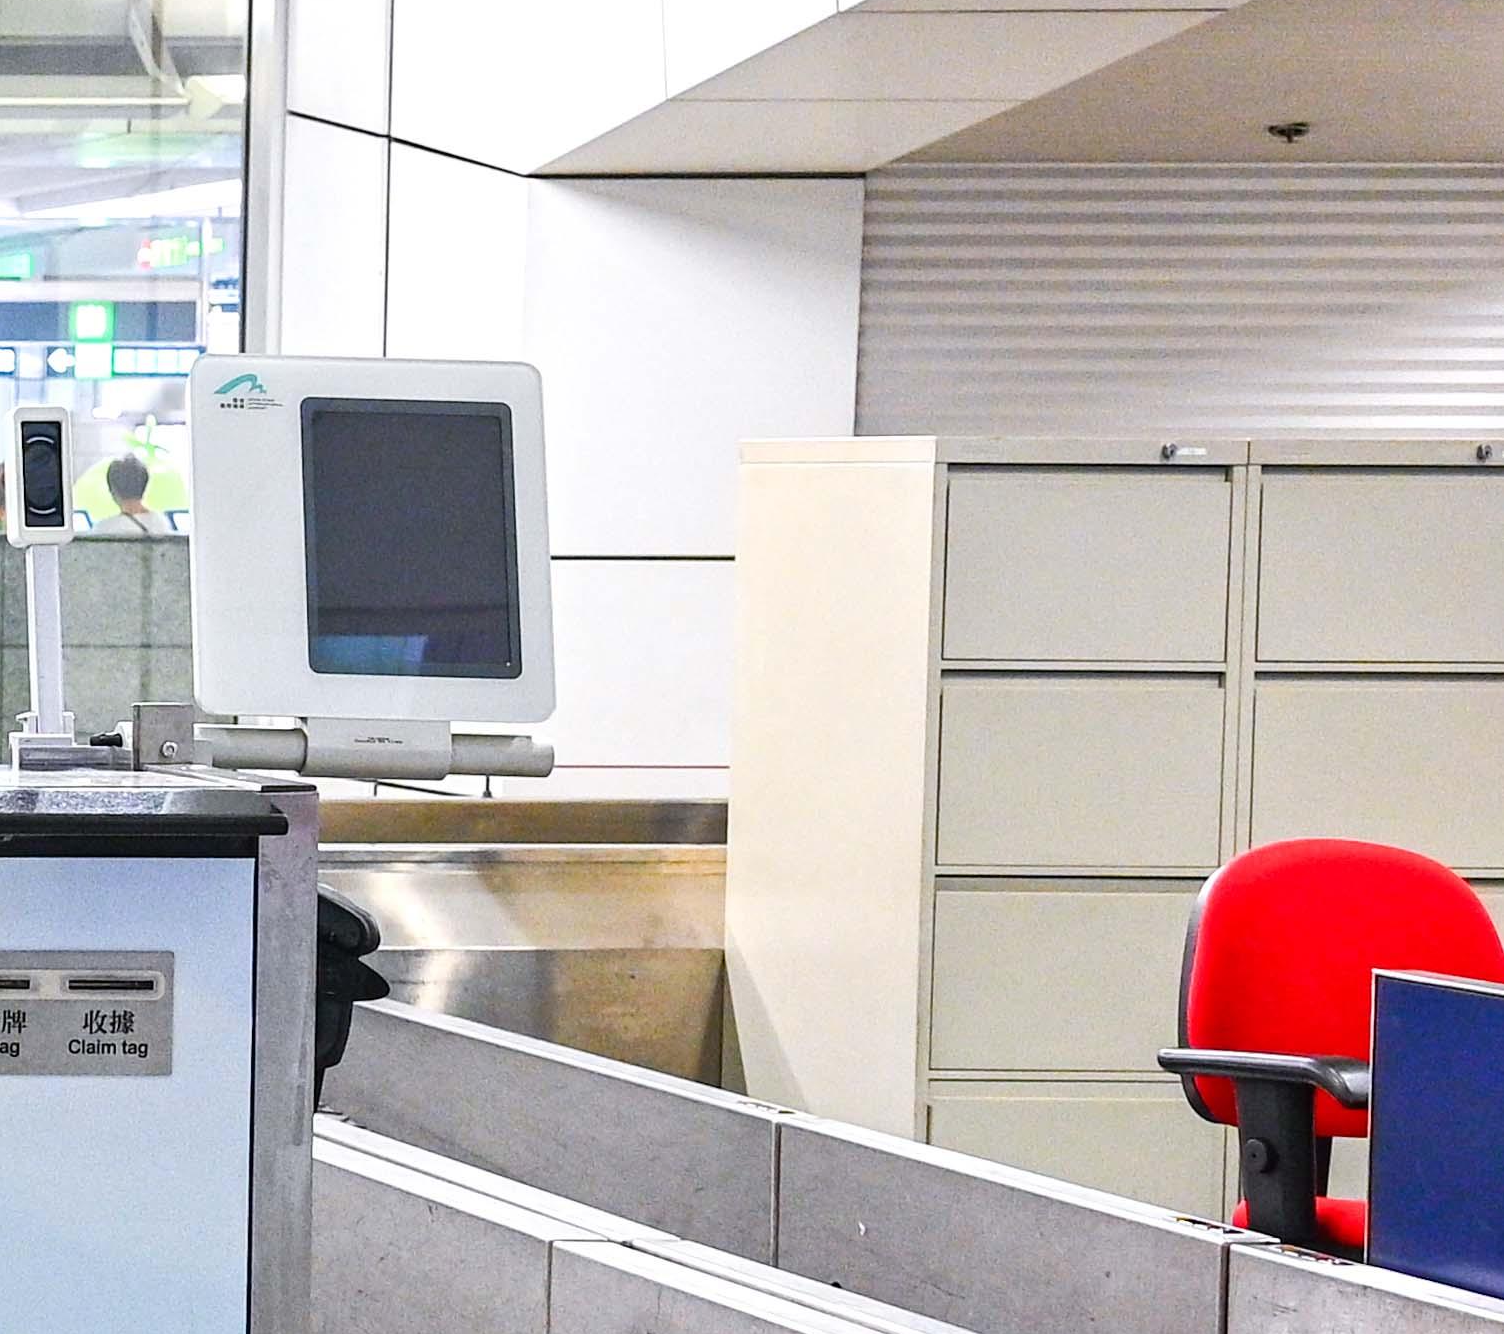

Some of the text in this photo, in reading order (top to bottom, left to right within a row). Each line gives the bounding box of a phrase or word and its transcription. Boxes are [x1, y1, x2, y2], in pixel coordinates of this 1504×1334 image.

[82, 1009, 135, 1035] 收據
[68, 1038, 149, 1059] Claim tag
